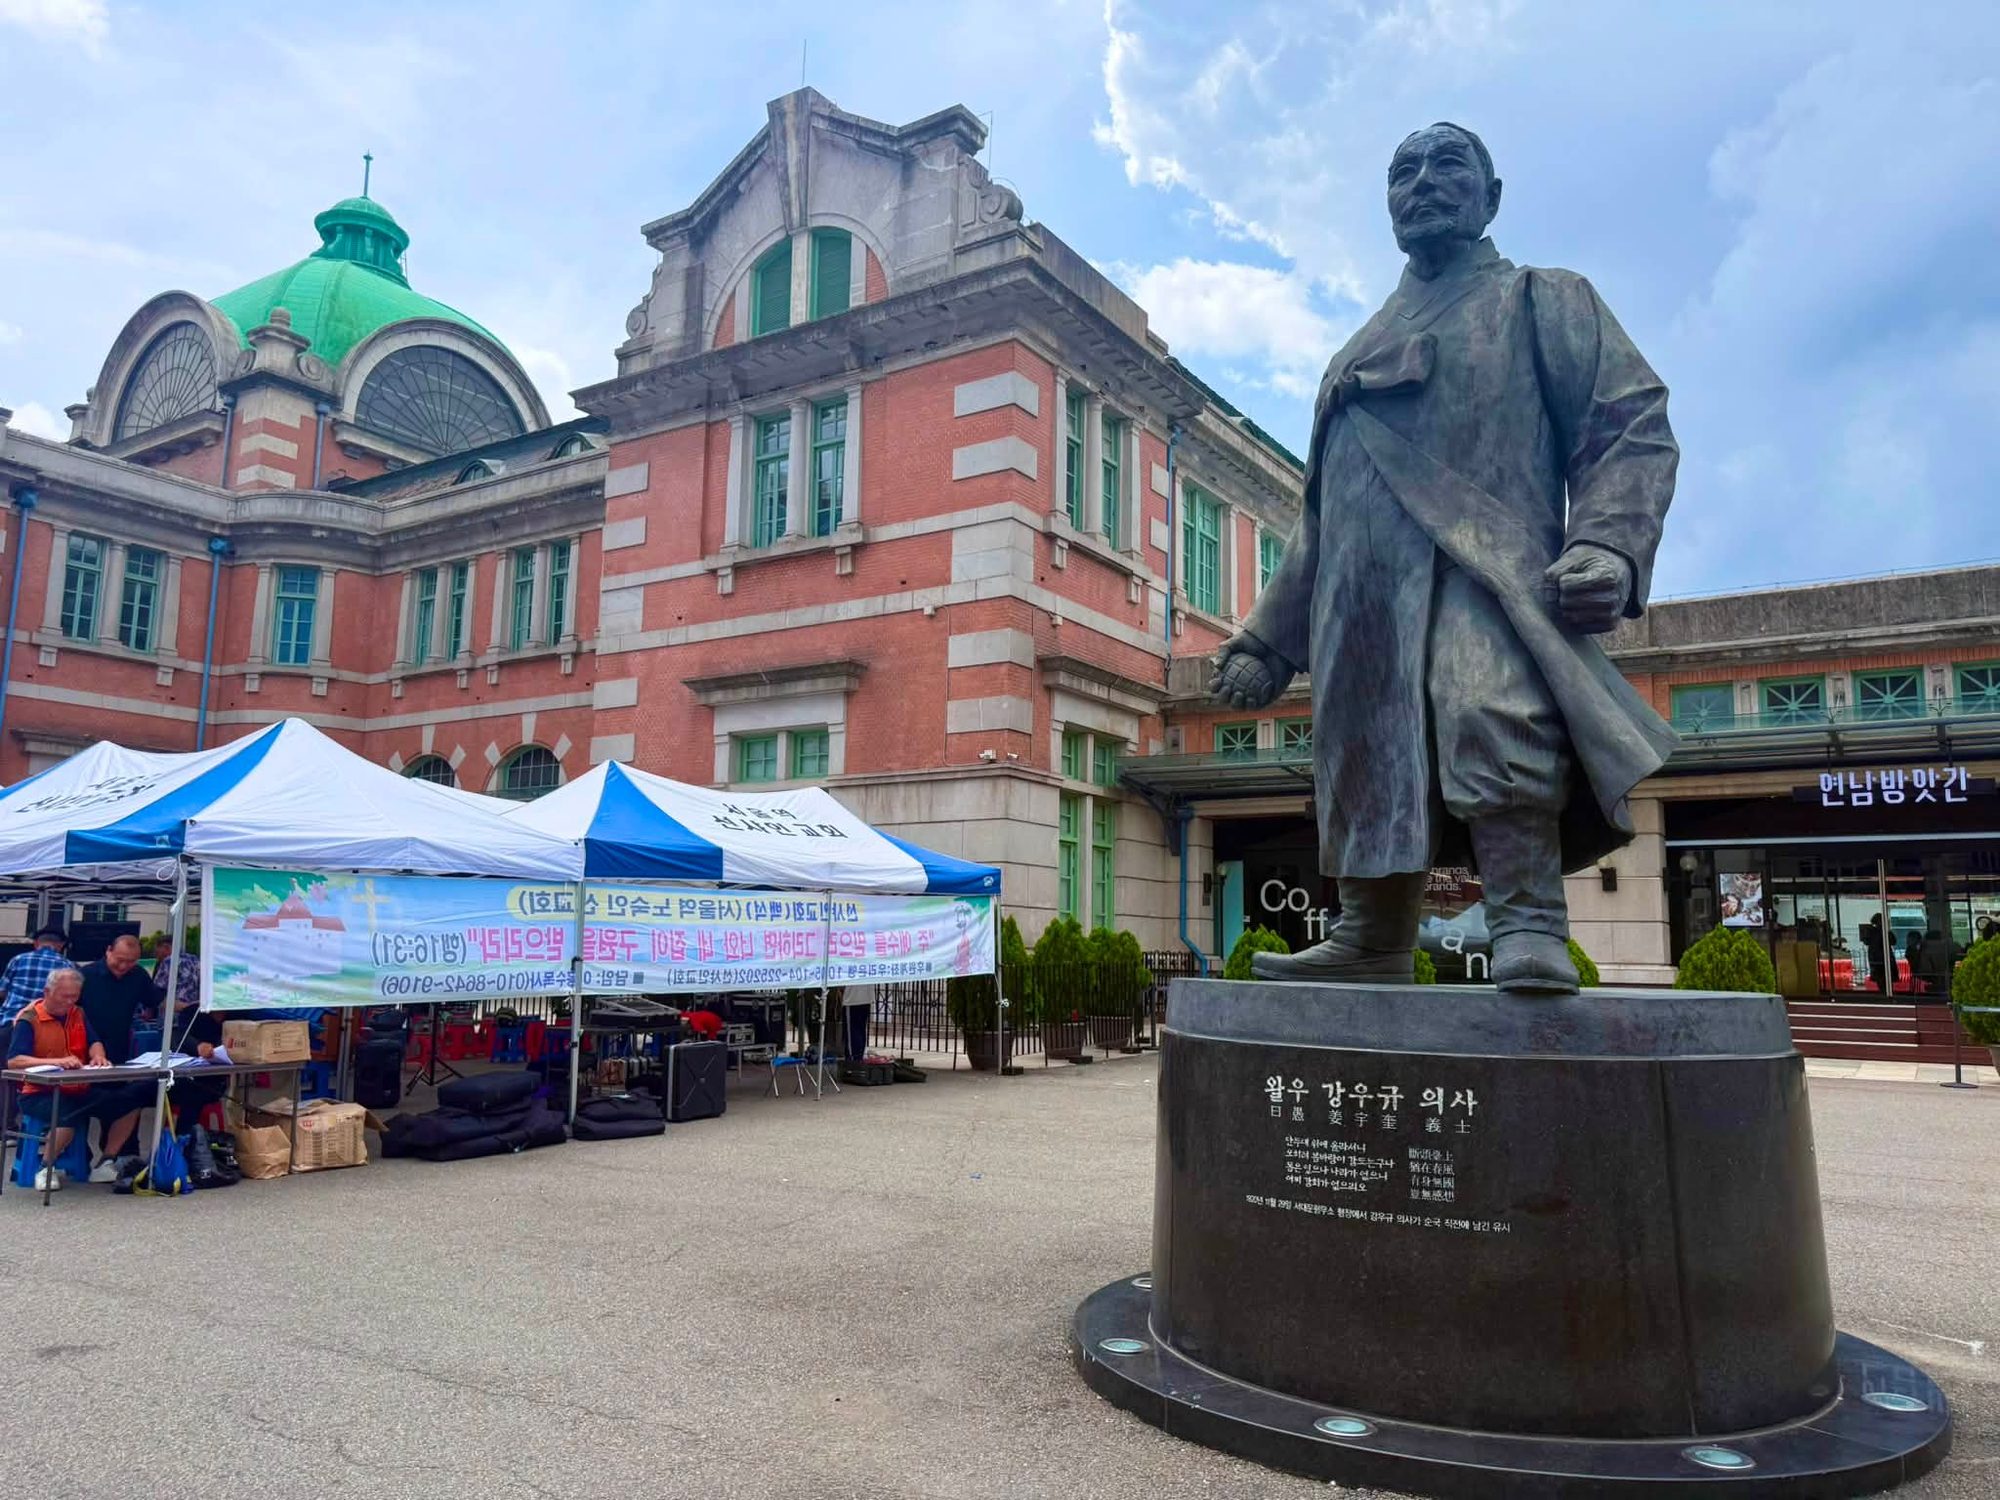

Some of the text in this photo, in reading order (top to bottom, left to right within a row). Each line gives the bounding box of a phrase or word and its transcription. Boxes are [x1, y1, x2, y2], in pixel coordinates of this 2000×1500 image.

[1819, 767, 1972, 806] 연남방앗간
[722, 803, 797, 820] 서울역
[1264, 1075, 1478, 1116] 왈우 강우규 의사
[1370, 1211, 1394, 1222] 강우규
[1397, 1214, 1421, 1225] 의사가
